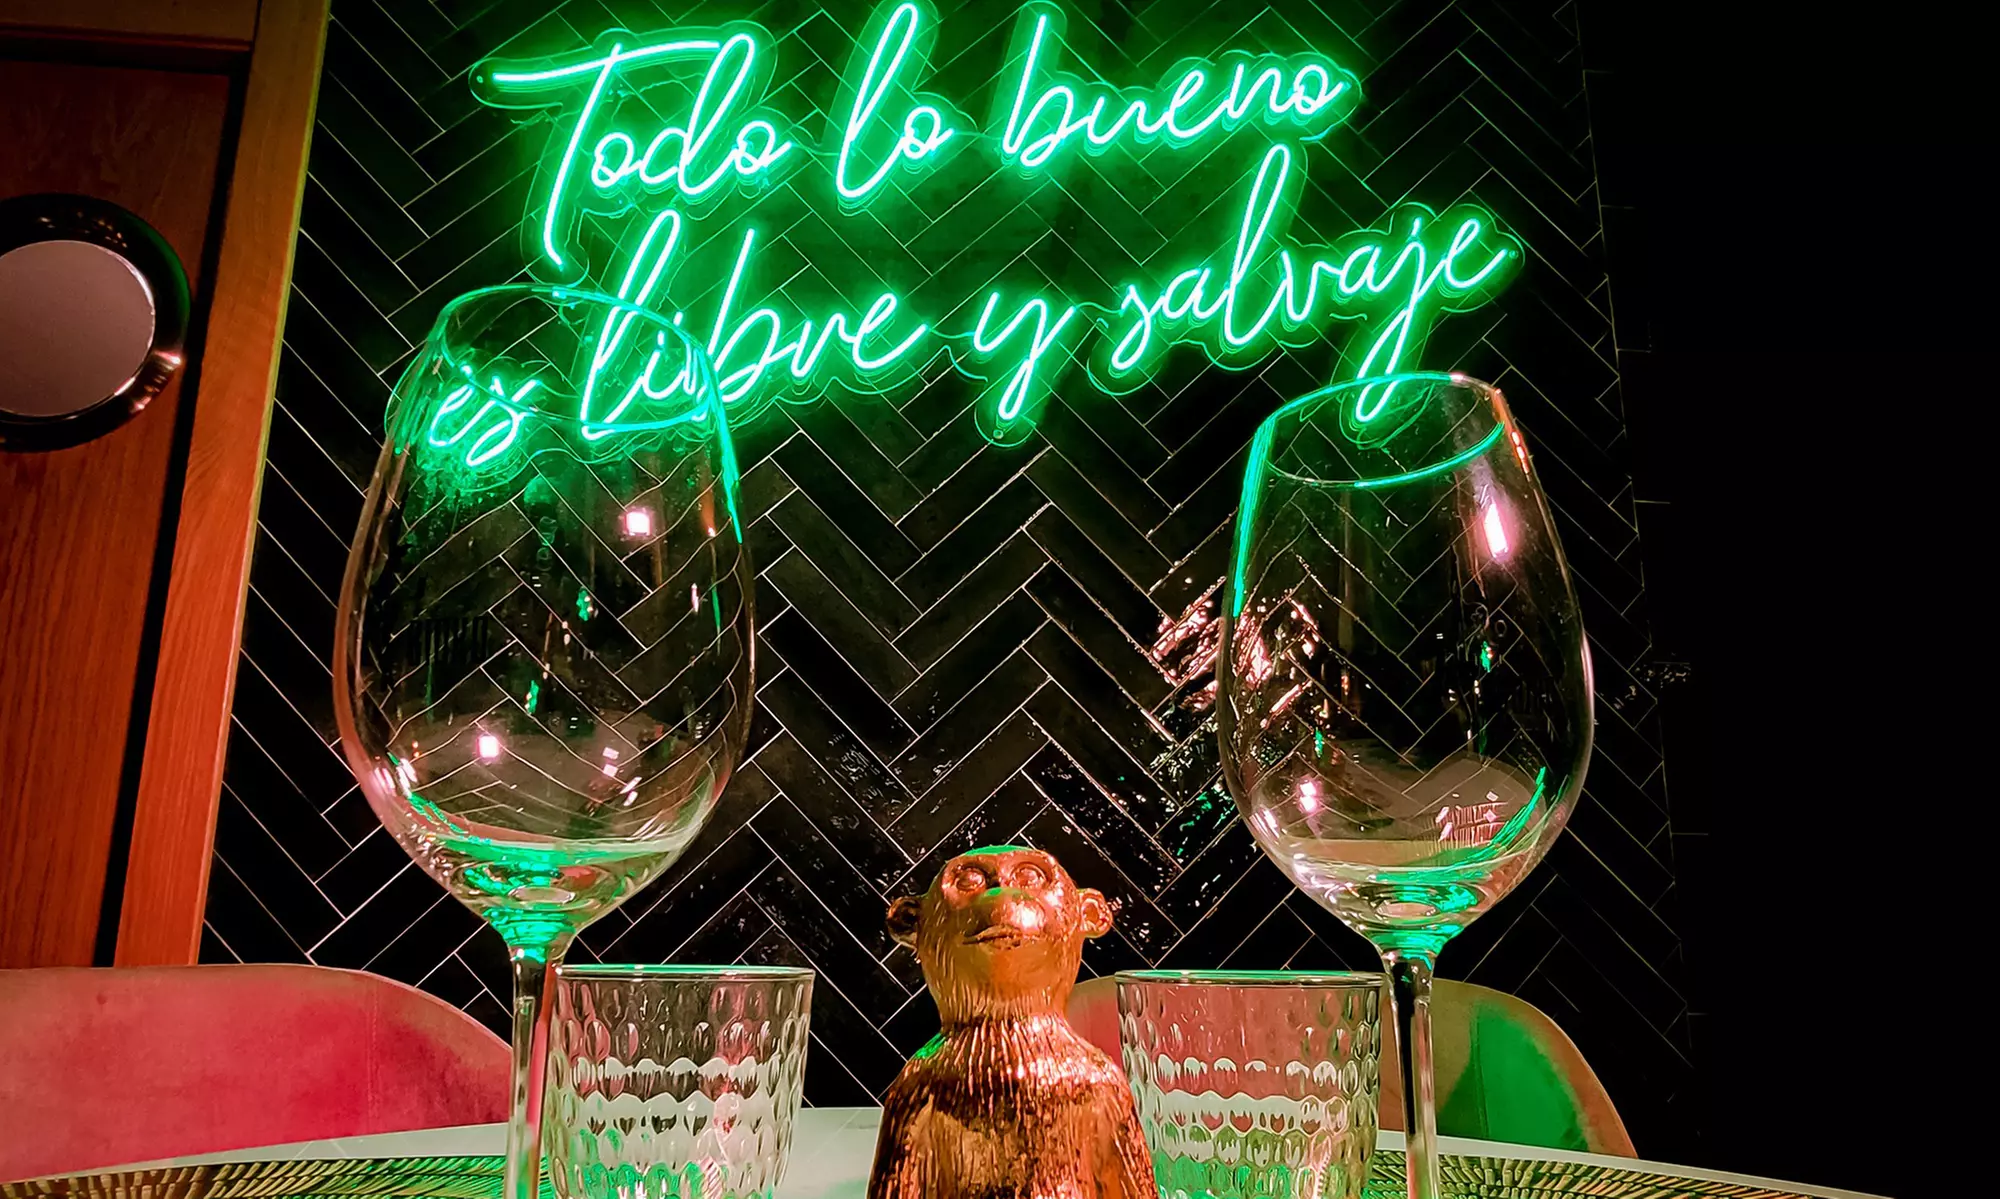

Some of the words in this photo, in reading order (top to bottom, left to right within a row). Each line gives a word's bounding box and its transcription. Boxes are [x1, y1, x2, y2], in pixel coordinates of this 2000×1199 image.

[491, 31, 793, 270] Todo
[835, 2, 955, 199] lo
[1002, 13, 1347, 168] bueno
[580, 208, 928, 441] libre
[972, 291, 1076, 420] y
[1111, 143, 1509, 422] salvaje
